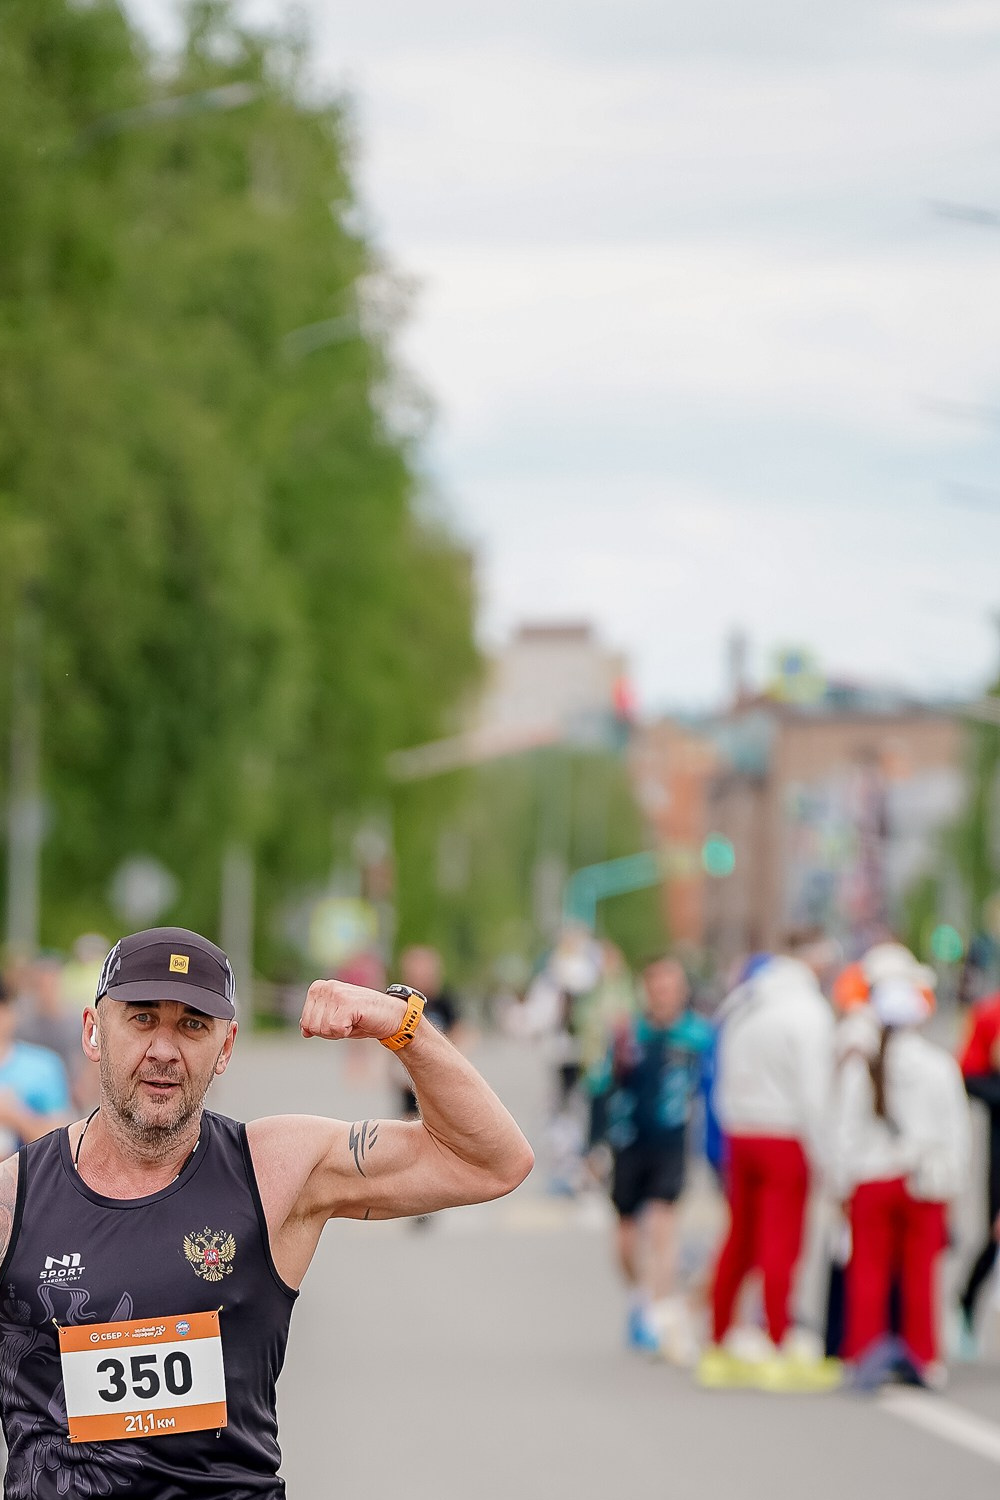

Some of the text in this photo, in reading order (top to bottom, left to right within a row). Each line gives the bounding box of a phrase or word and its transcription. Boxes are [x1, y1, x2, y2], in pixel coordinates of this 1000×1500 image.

[39, 1267, 86, 1279] SPORT
[43, 1276, 81, 1284] LABORATORY
[100, 1332, 122, 1341] СБЕР
[96, 1351, 193, 1402] 350
